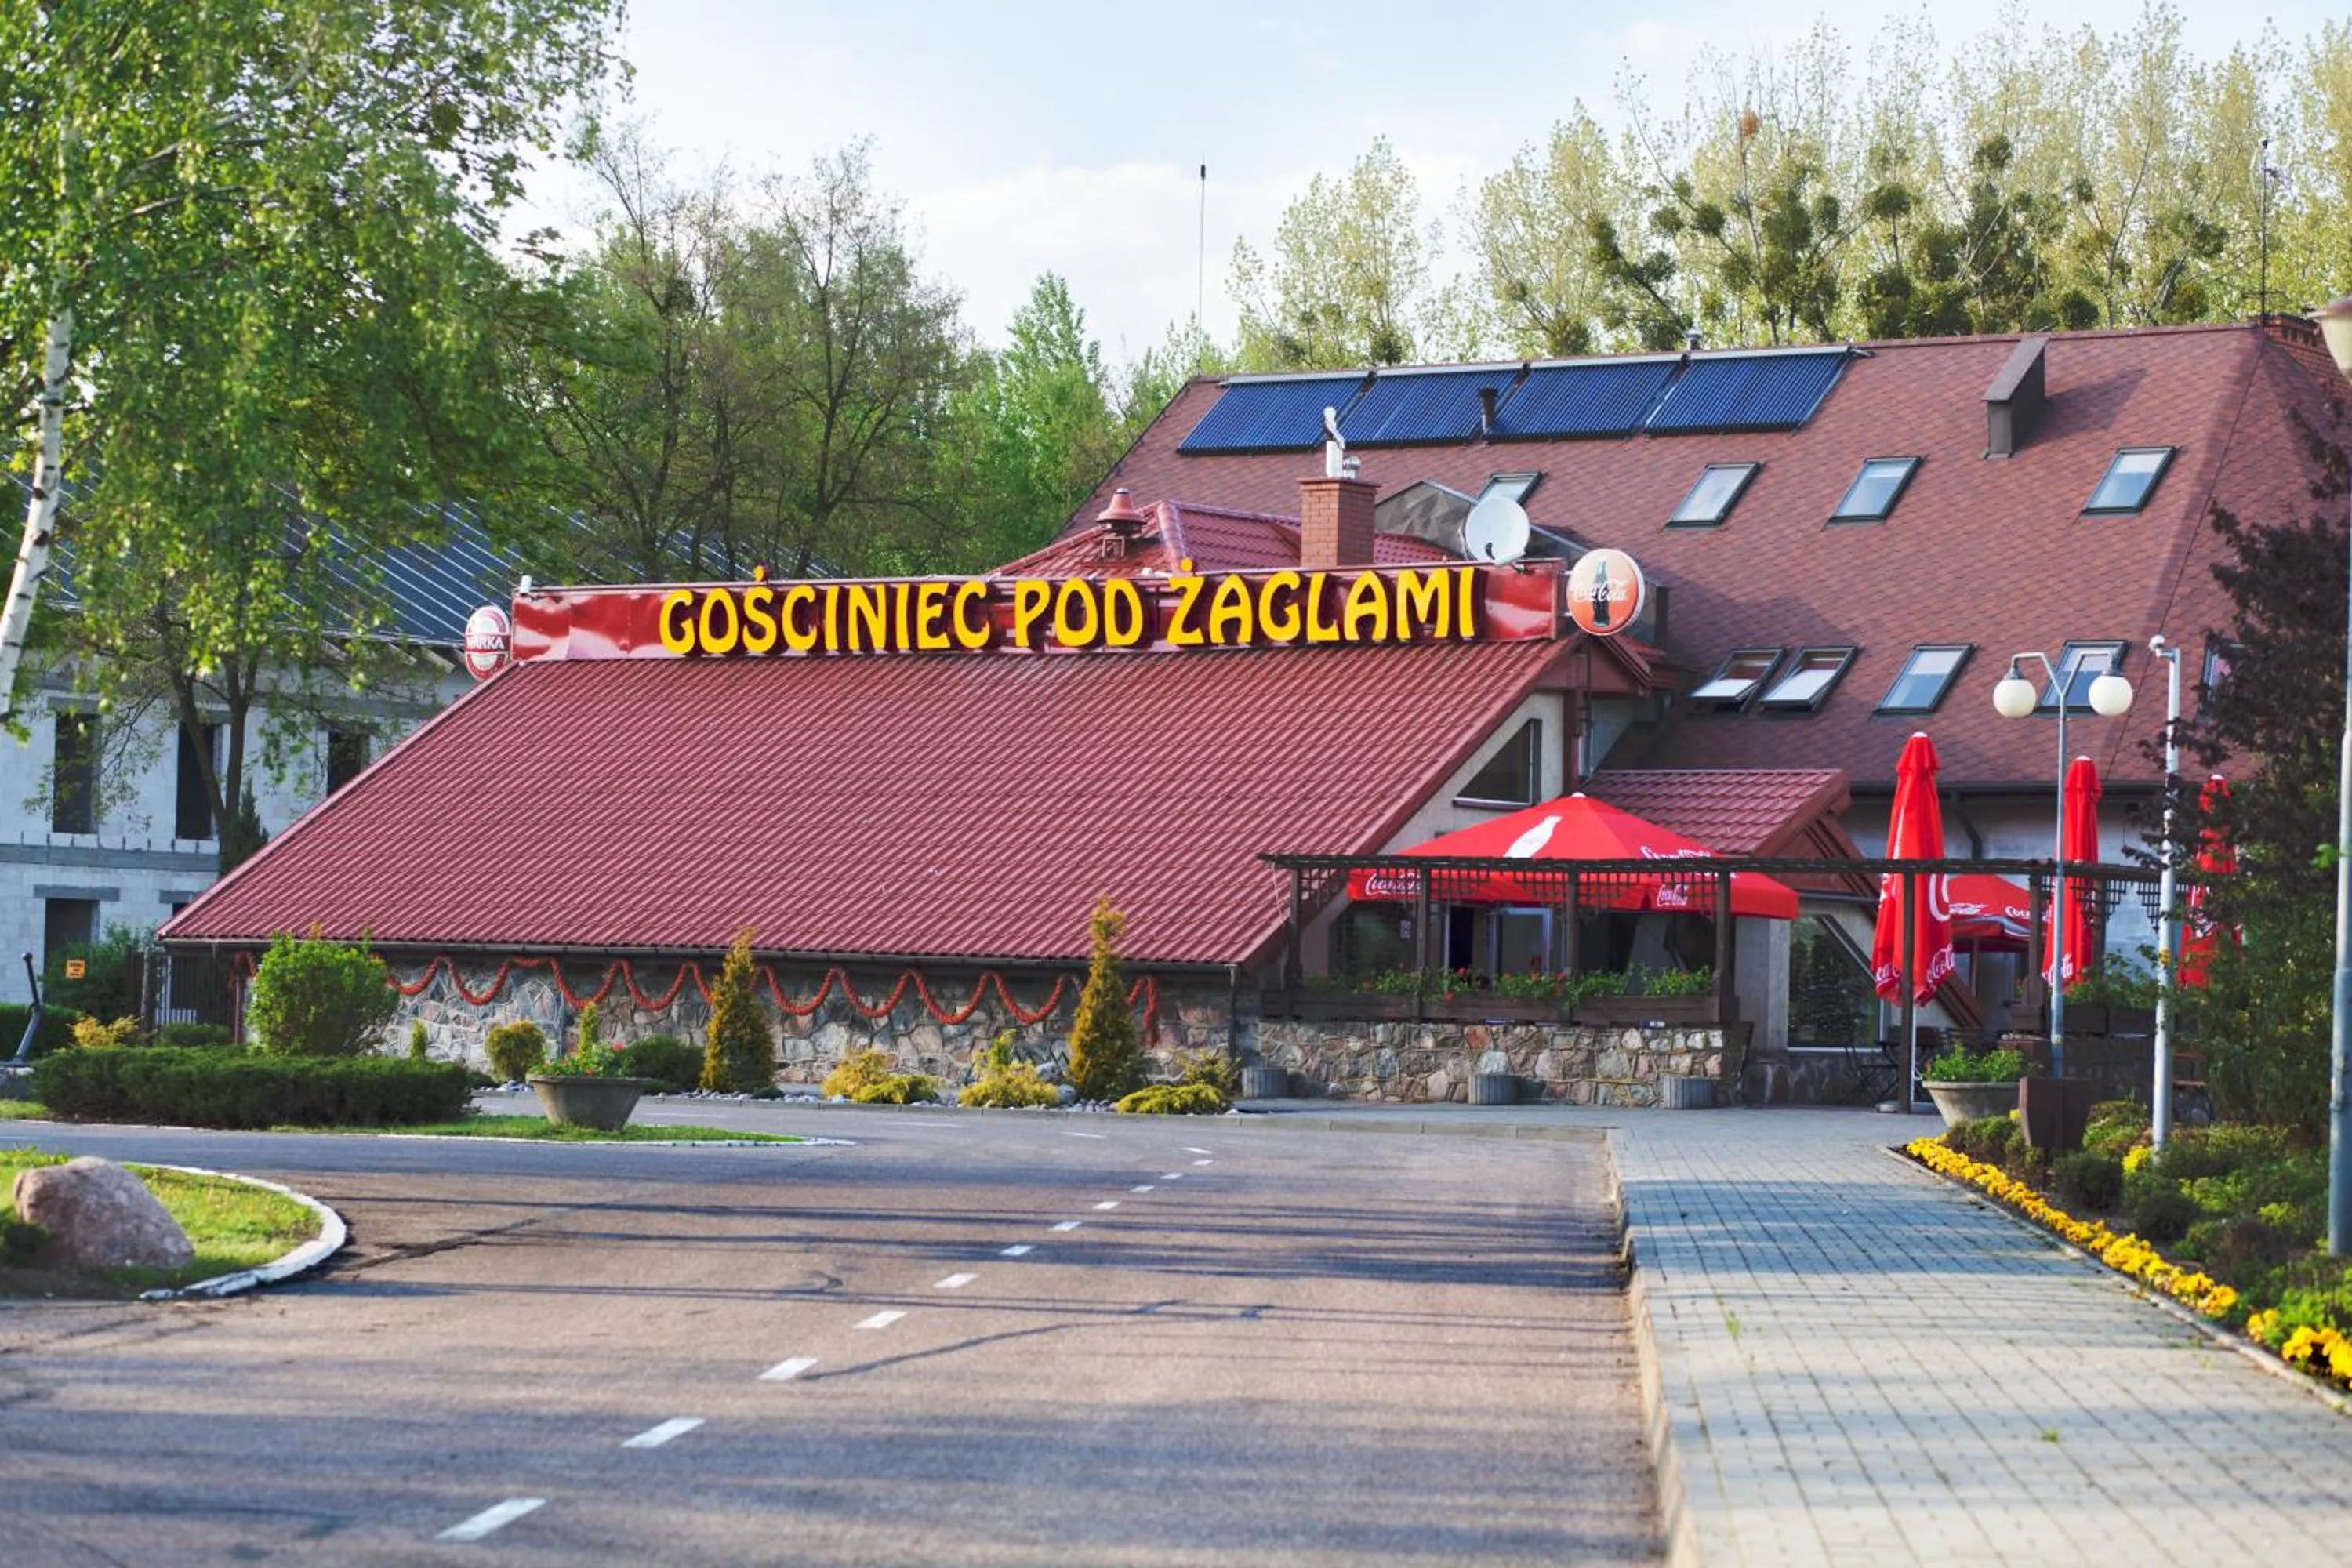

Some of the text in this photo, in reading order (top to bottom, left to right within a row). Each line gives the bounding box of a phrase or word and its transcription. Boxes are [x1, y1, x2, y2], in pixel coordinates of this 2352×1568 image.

[660, 559, 1475, 654] GOŚCINIEC POD ŻAGLAMI
